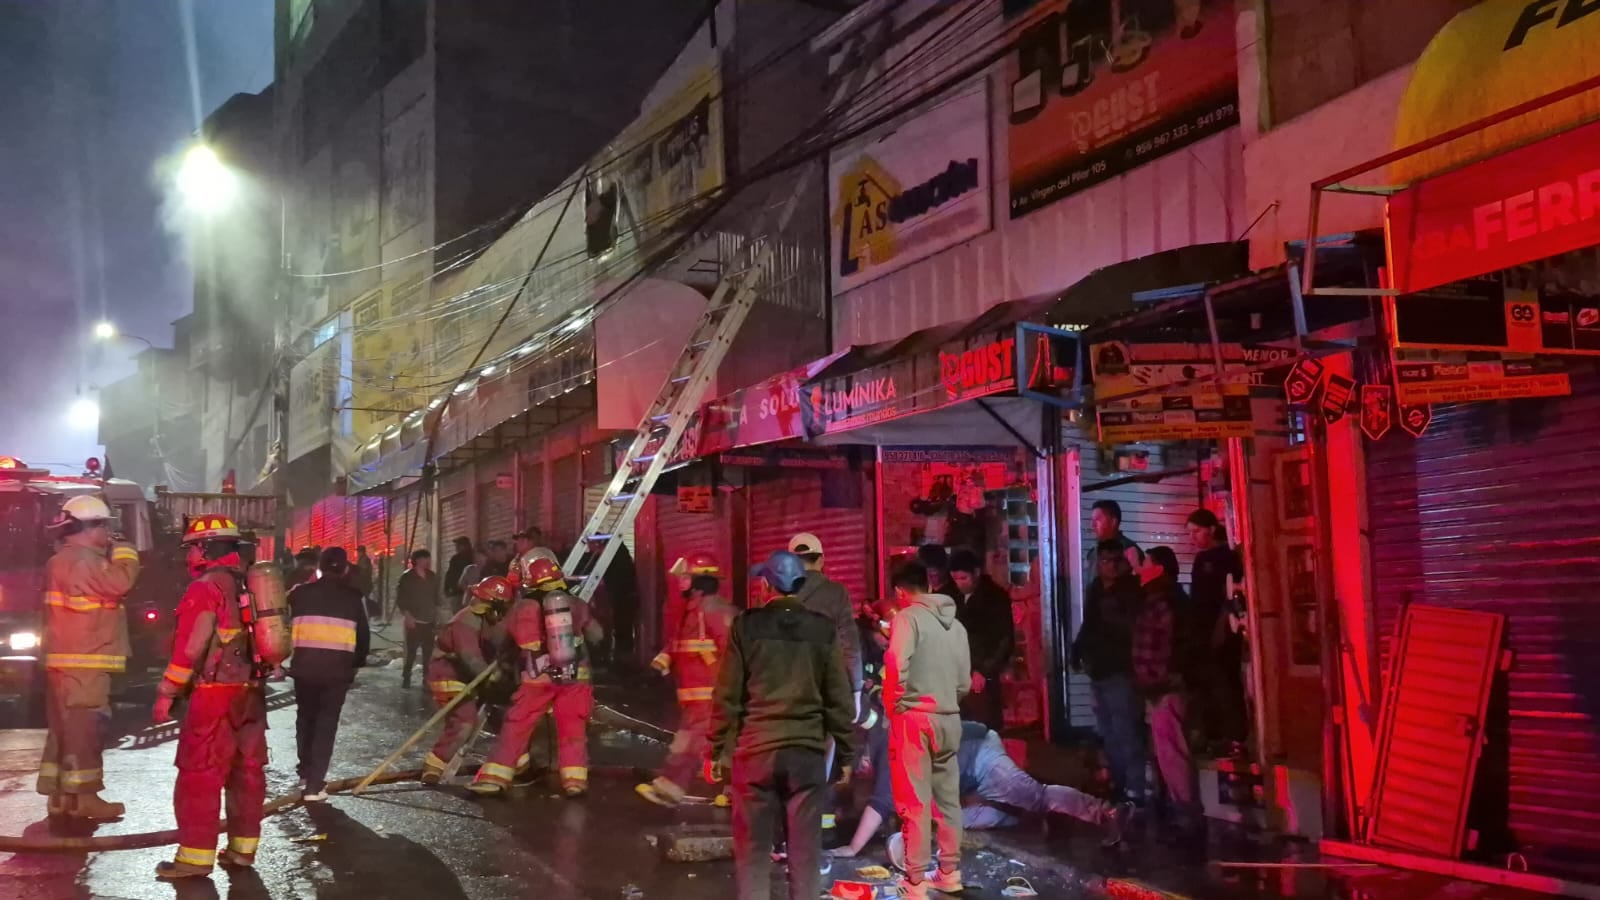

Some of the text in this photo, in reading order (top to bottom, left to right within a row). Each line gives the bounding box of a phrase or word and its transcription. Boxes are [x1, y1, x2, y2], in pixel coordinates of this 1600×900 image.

[1057, 175, 1071, 190] del
[960, 338, 1015, 388] GUST
[824, 377, 896, 415] LUMÍNIKA
